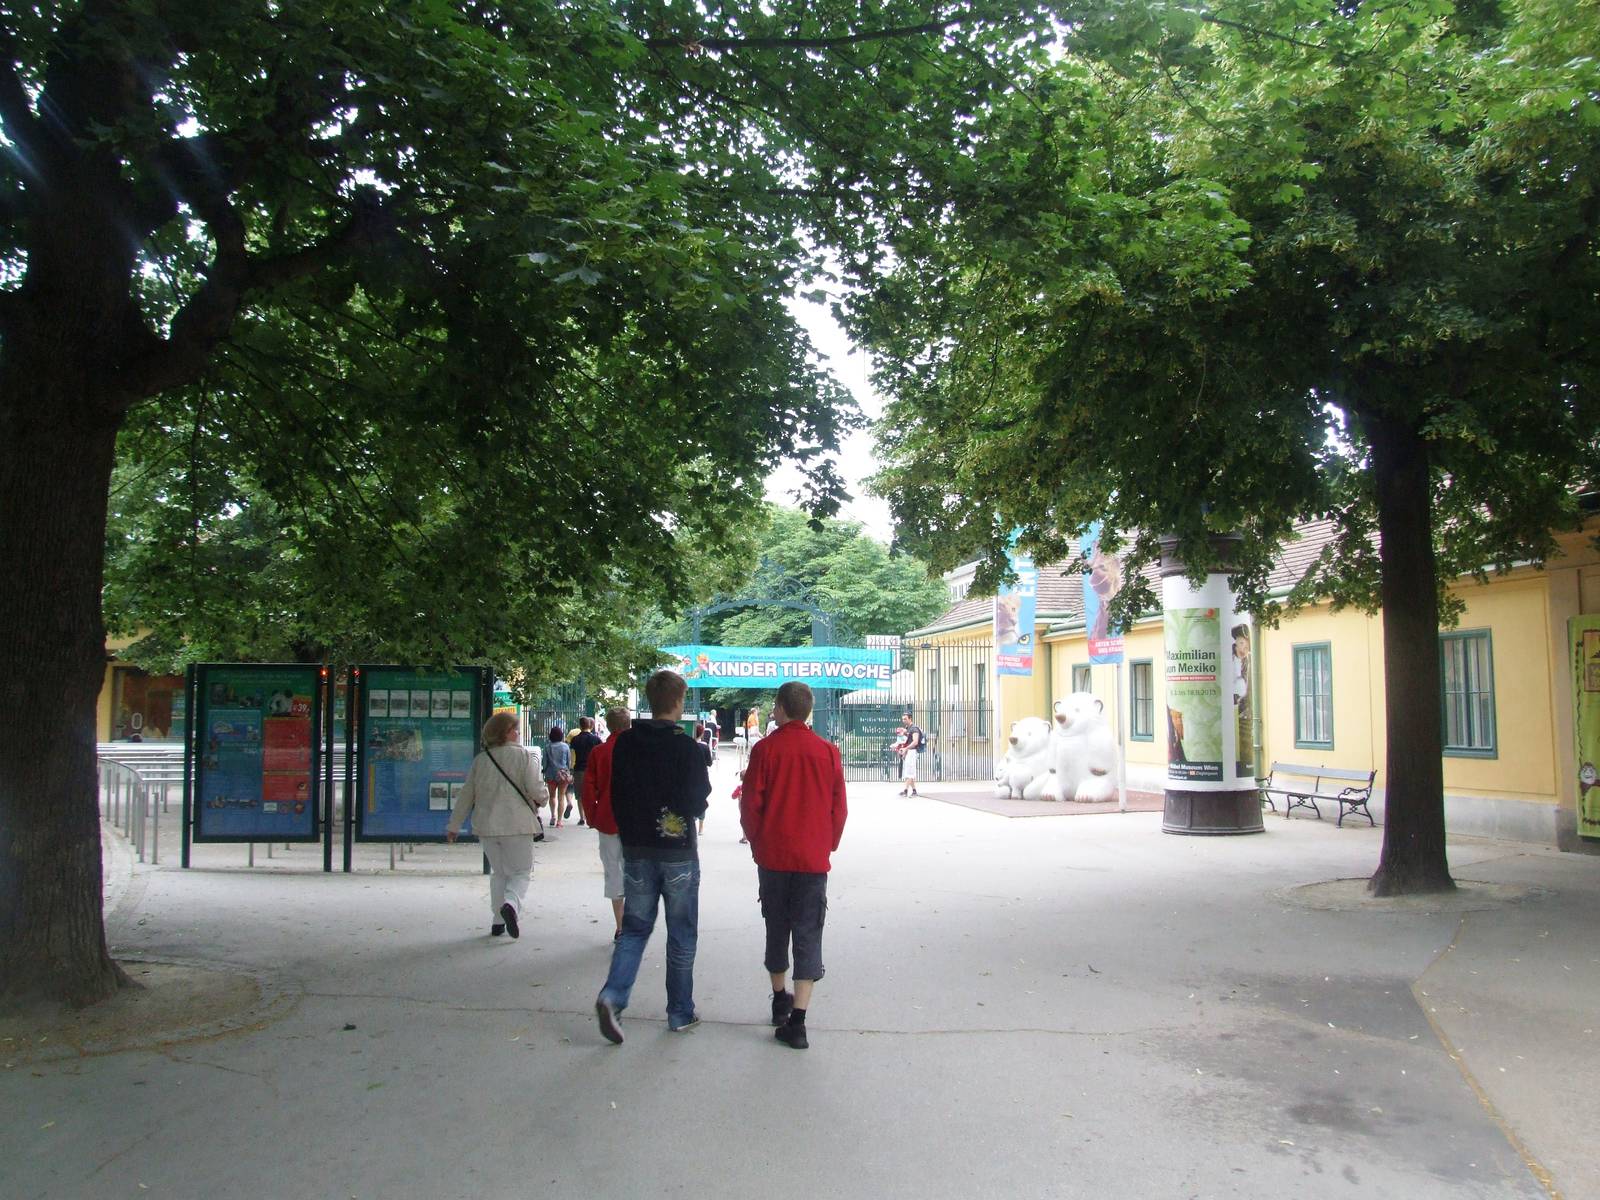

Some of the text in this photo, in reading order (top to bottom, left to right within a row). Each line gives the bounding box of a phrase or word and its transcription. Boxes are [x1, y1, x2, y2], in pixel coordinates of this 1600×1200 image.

[708, 661, 891, 680] KINDER TIER WOCHE
[1178, 663, 1216, 673] Mexiko
